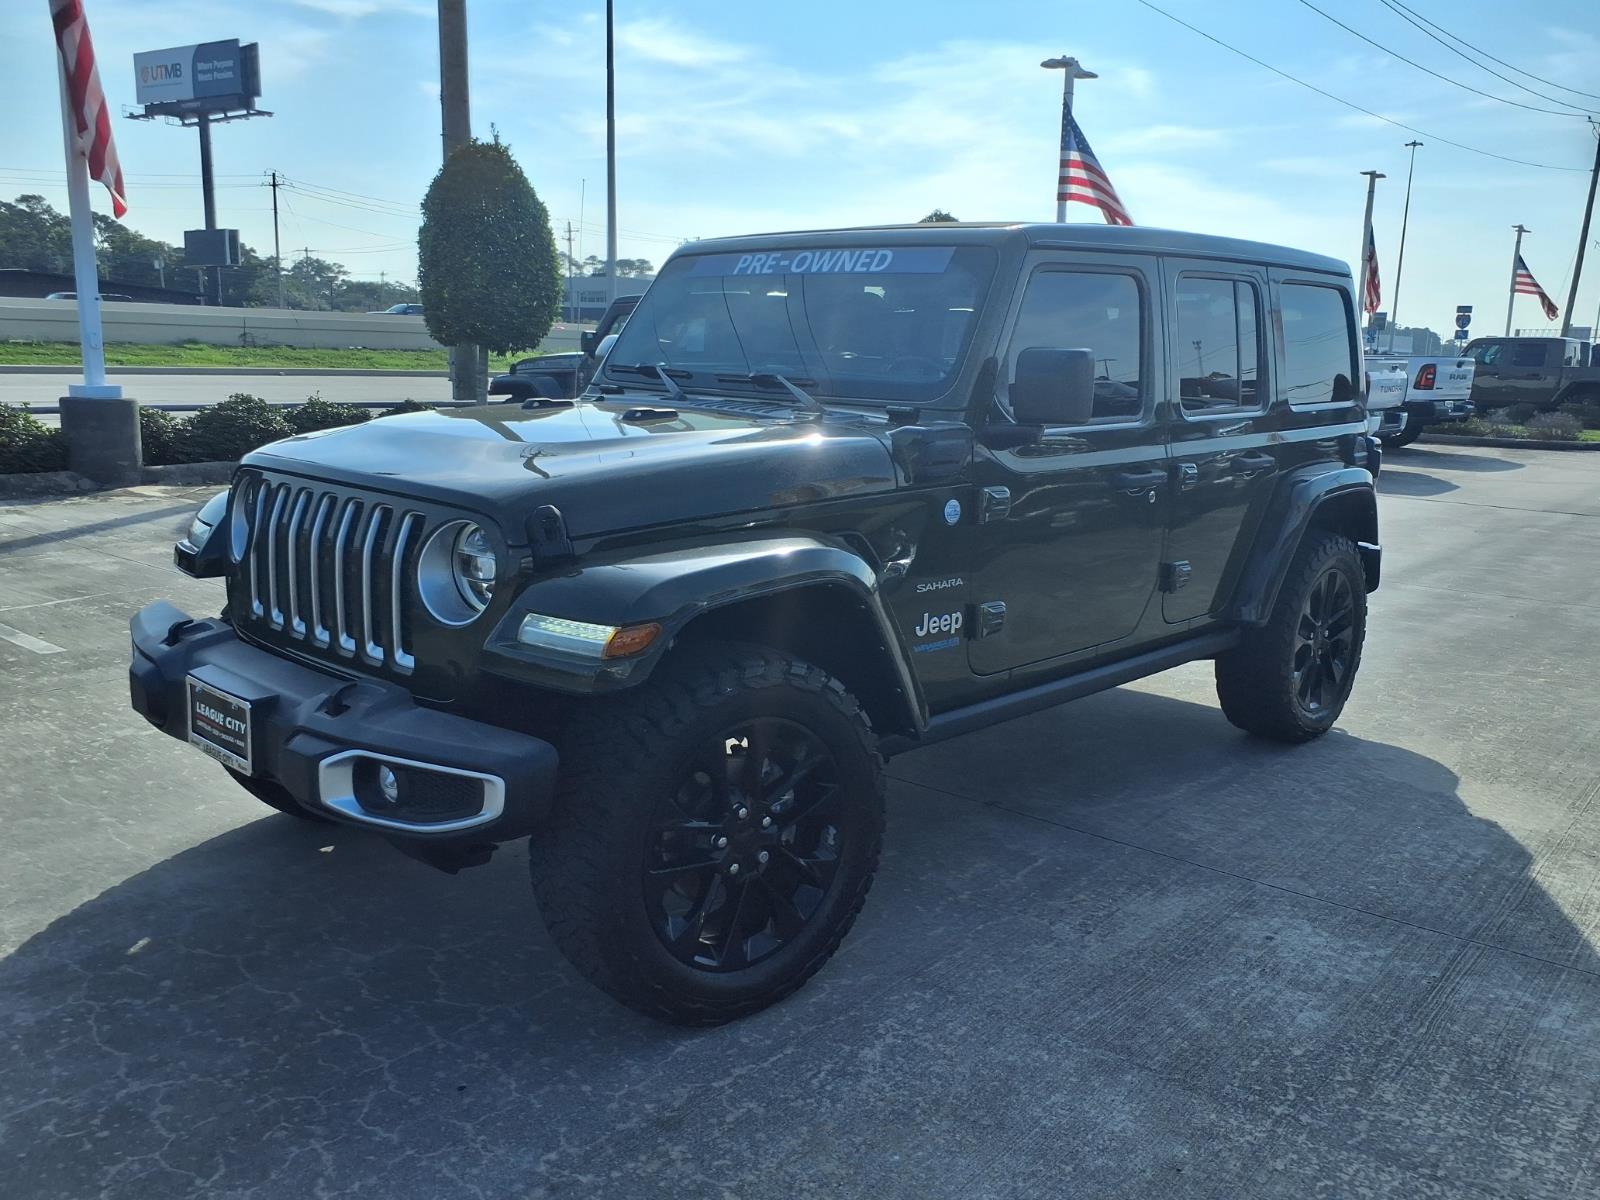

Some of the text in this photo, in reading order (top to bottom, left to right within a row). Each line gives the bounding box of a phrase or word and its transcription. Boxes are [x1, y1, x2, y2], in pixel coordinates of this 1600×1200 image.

[150, 62, 182, 81] UTMB
[733, 249, 894, 275] PRE-OWNED
[916, 577, 964, 593] SAHARA
[915, 611, 963, 637] Jeep
[196, 701, 224, 726] LEAGUE
[226, 716, 247, 734] CITY
